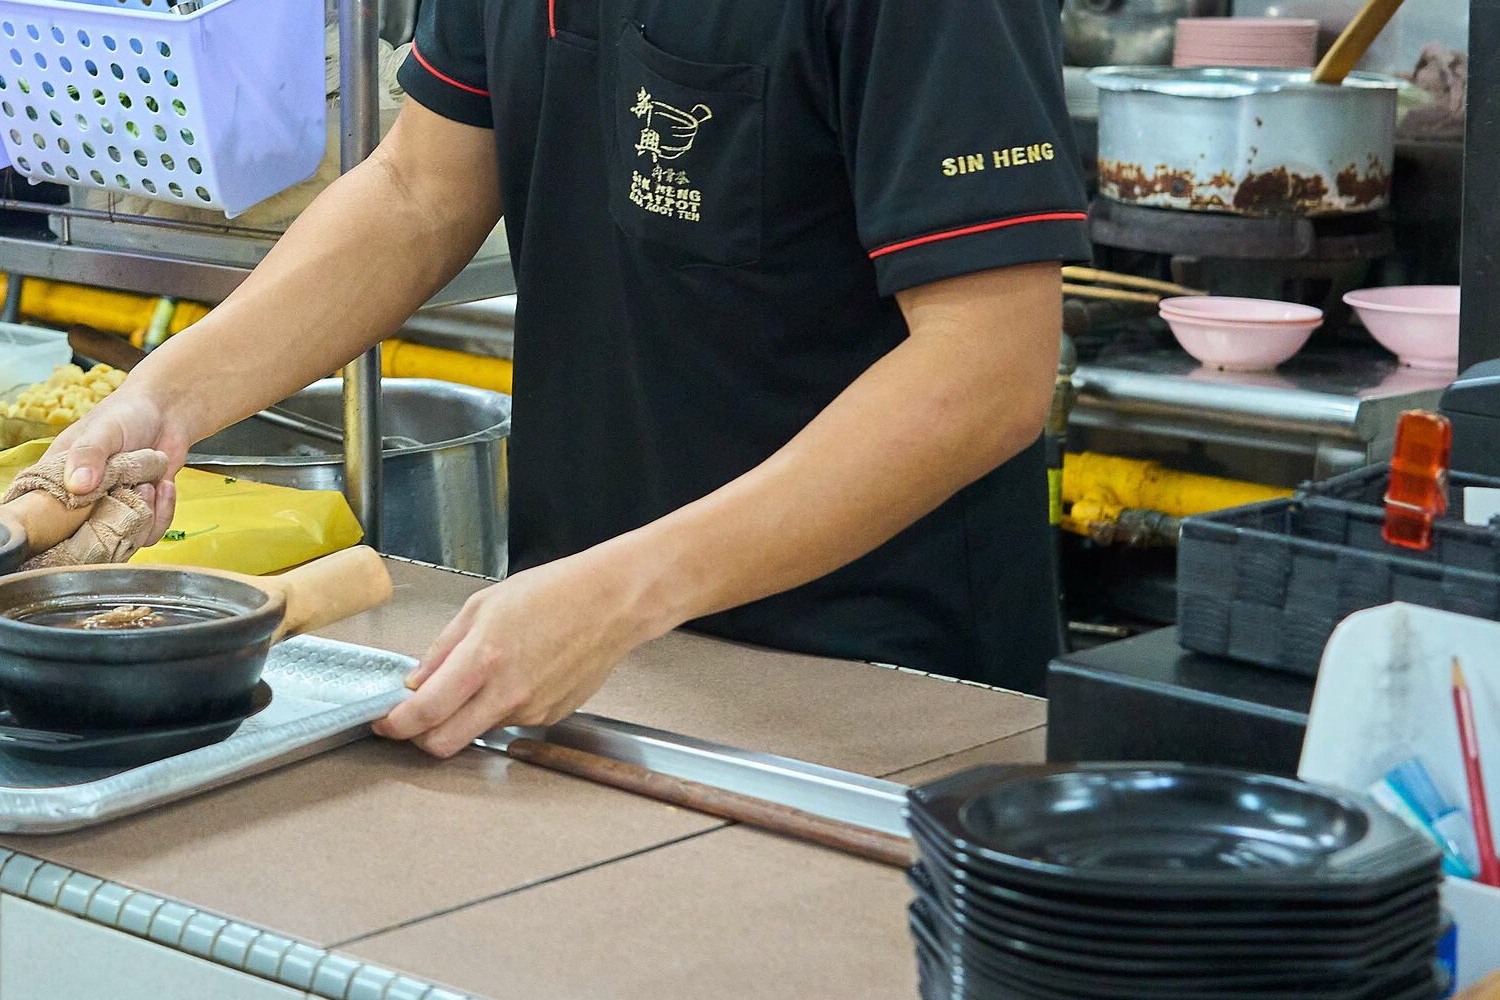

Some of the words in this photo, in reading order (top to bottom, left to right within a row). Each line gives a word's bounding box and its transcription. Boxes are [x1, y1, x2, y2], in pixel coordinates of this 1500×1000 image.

[941, 153, 985, 176] SIN
[992, 142, 1054, 168] HENG
[655, 184, 701, 202] HENG
